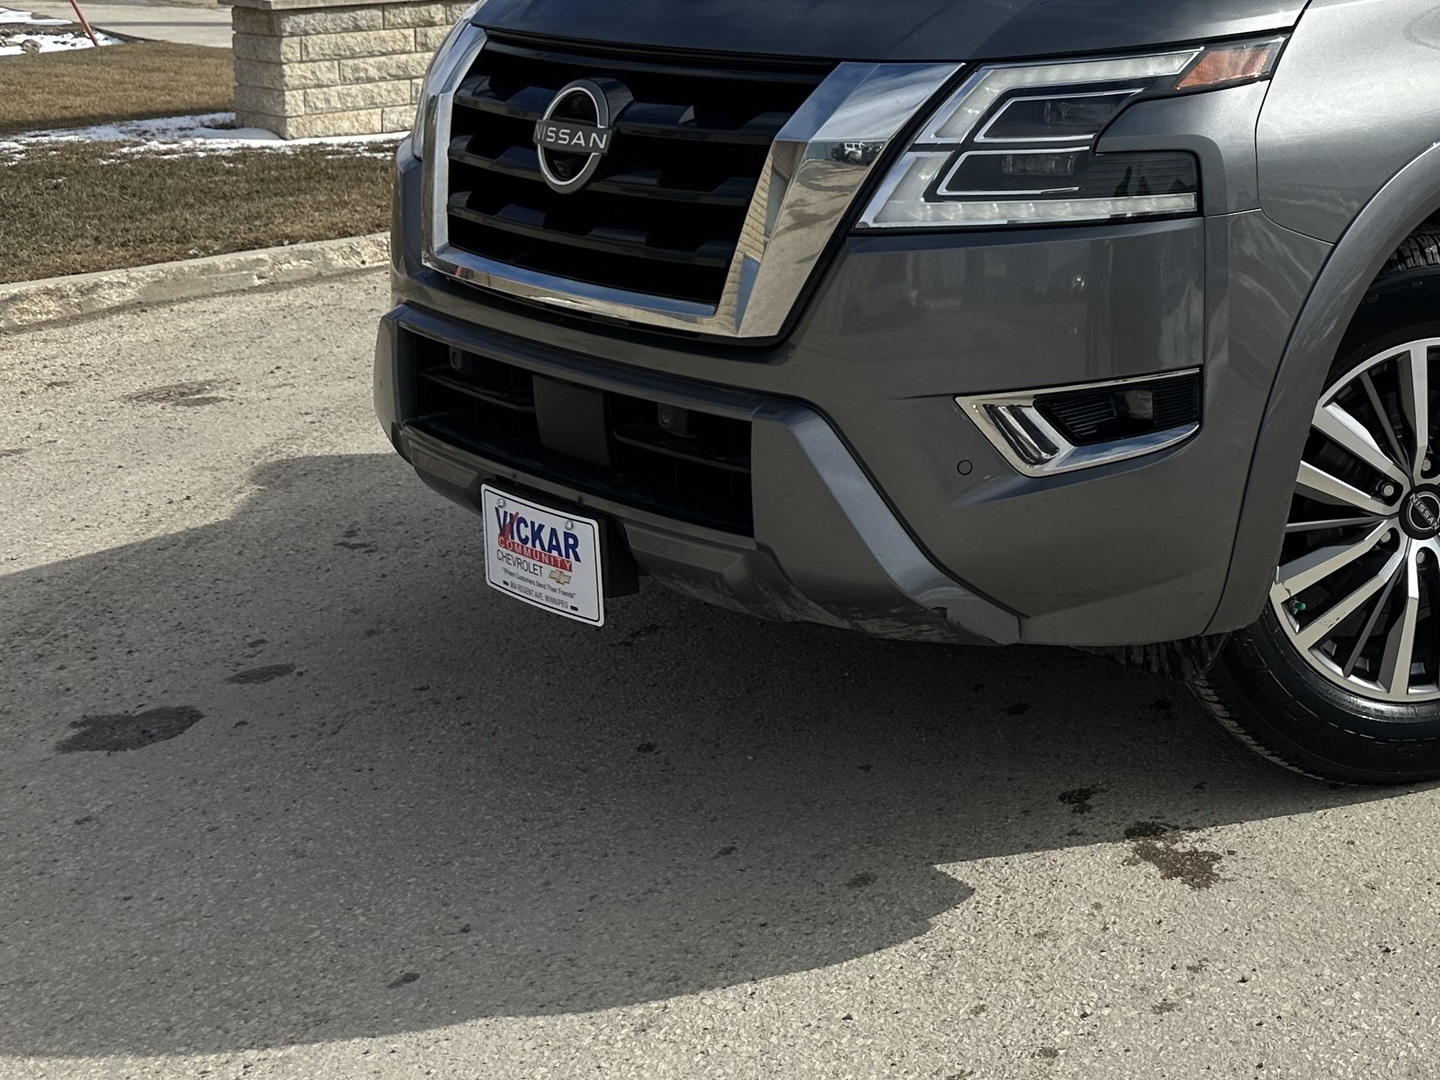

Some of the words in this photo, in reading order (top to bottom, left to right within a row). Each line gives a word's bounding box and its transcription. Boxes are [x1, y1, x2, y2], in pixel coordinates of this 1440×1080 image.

[536, 124, 607, 149] NISSAN
[1409, 493, 1440, 530] NISSAN
[495, 507, 581, 563] VICKAR
[497, 549, 543, 577] CHEVROLET
[498, 536, 572, 570] COMMUNITY
